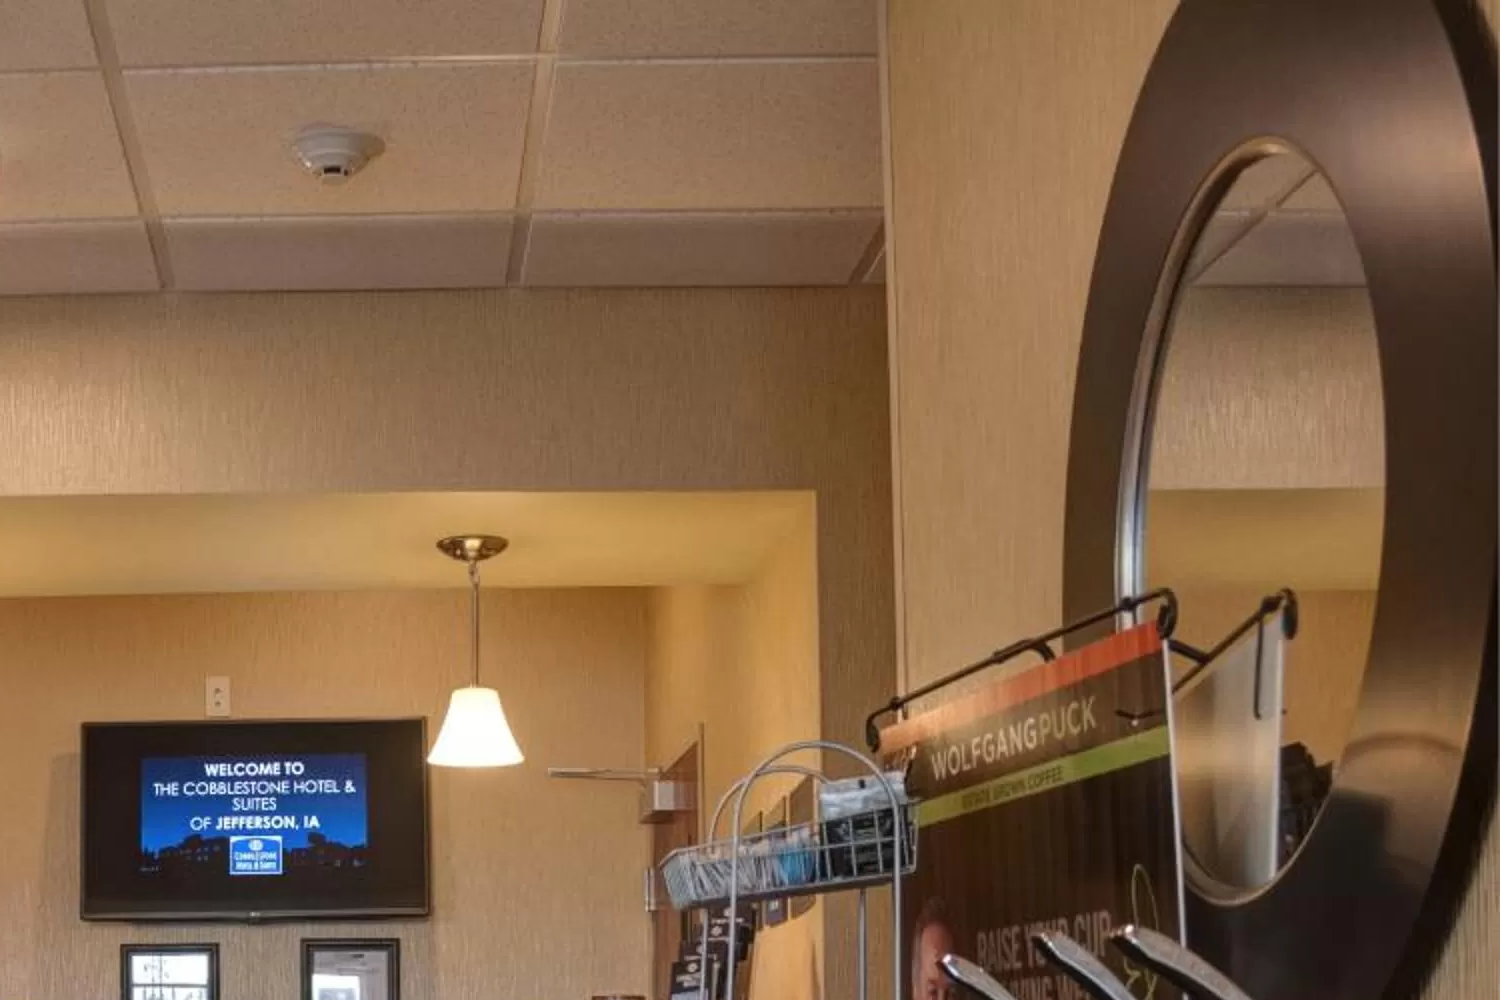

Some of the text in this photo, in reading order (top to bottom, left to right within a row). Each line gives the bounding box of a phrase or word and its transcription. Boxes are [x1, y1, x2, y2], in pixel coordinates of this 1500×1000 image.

[931, 695, 1097, 781] WOLFGANG PUCK
[204, 762, 305, 777] WELCOME TO
[153, 779, 356, 797] THE COBBLESTONE HOTEL &
[232, 797, 277, 812] SUITES
[190, 815, 320, 831] OF JEFFERSON, IA
[977, 925, 1023, 974] RAISE
[1074, 910, 1112, 958] CUP
